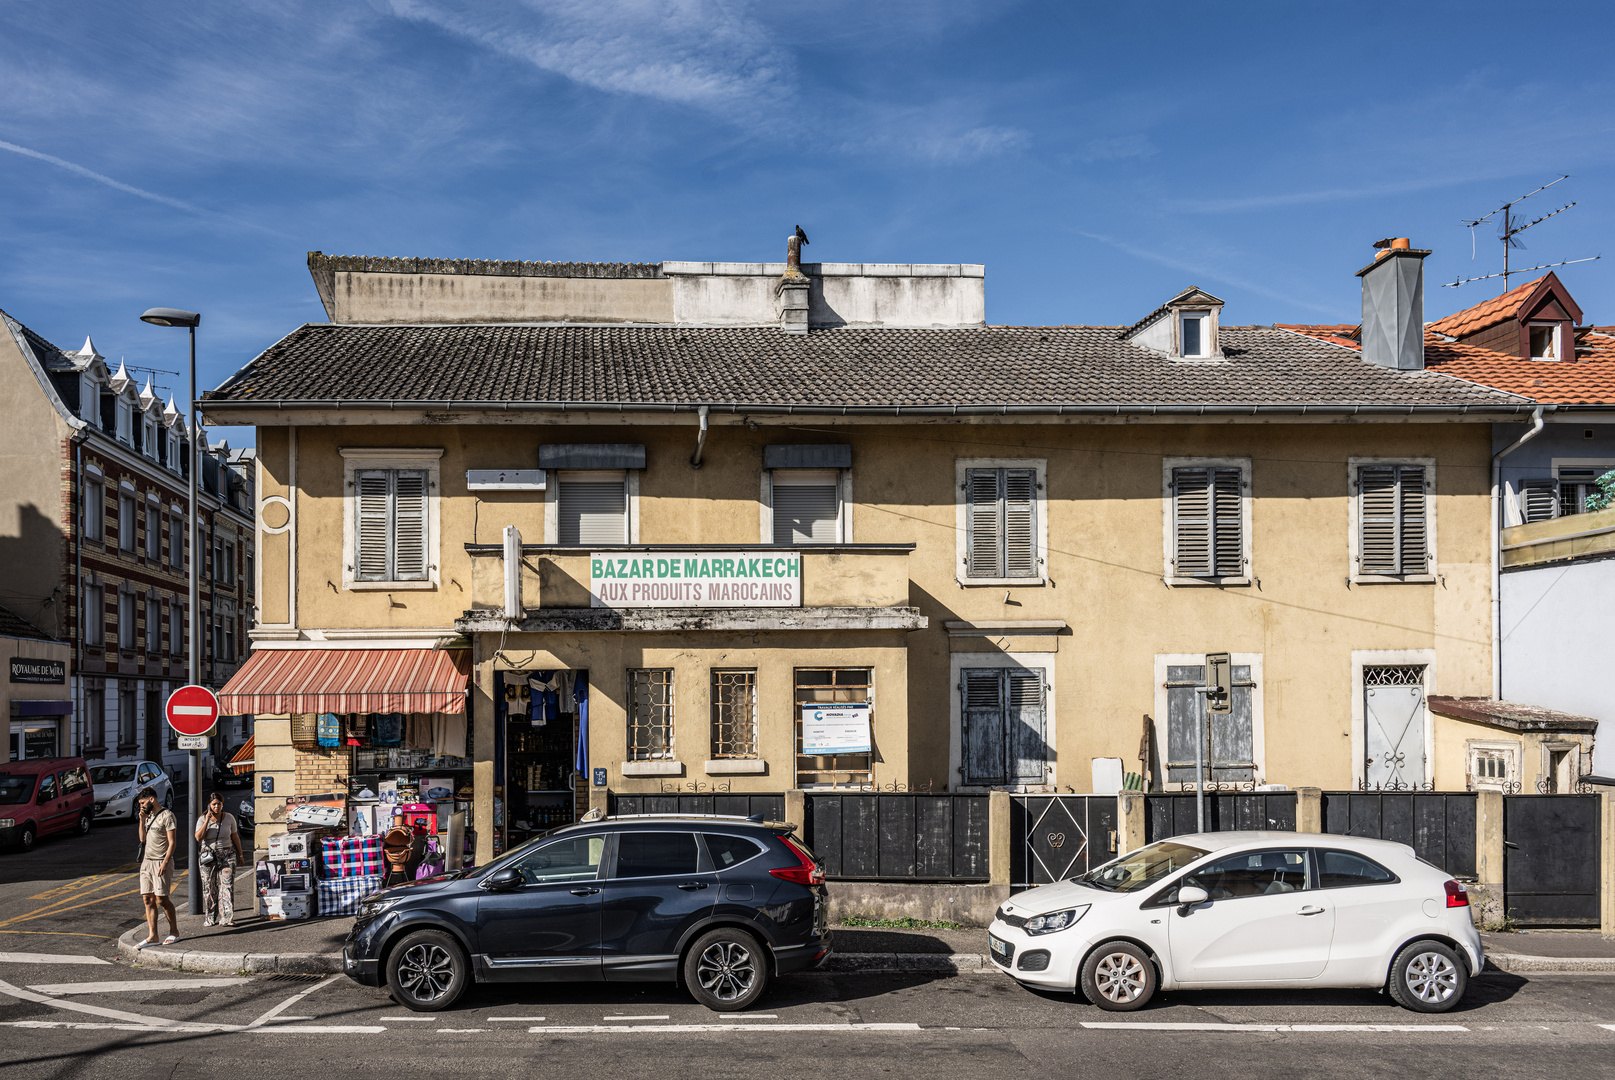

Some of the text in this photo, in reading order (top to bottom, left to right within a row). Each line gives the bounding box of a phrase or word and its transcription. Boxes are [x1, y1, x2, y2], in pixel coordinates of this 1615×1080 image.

[592, 558, 799, 578] BAZAR DE MARRAKECH
[599, 583, 792, 601] AUX PRODUITS MAROCAINS
[12, 664, 40, 676] ROYAUME
[41, 665, 49, 675] DE
